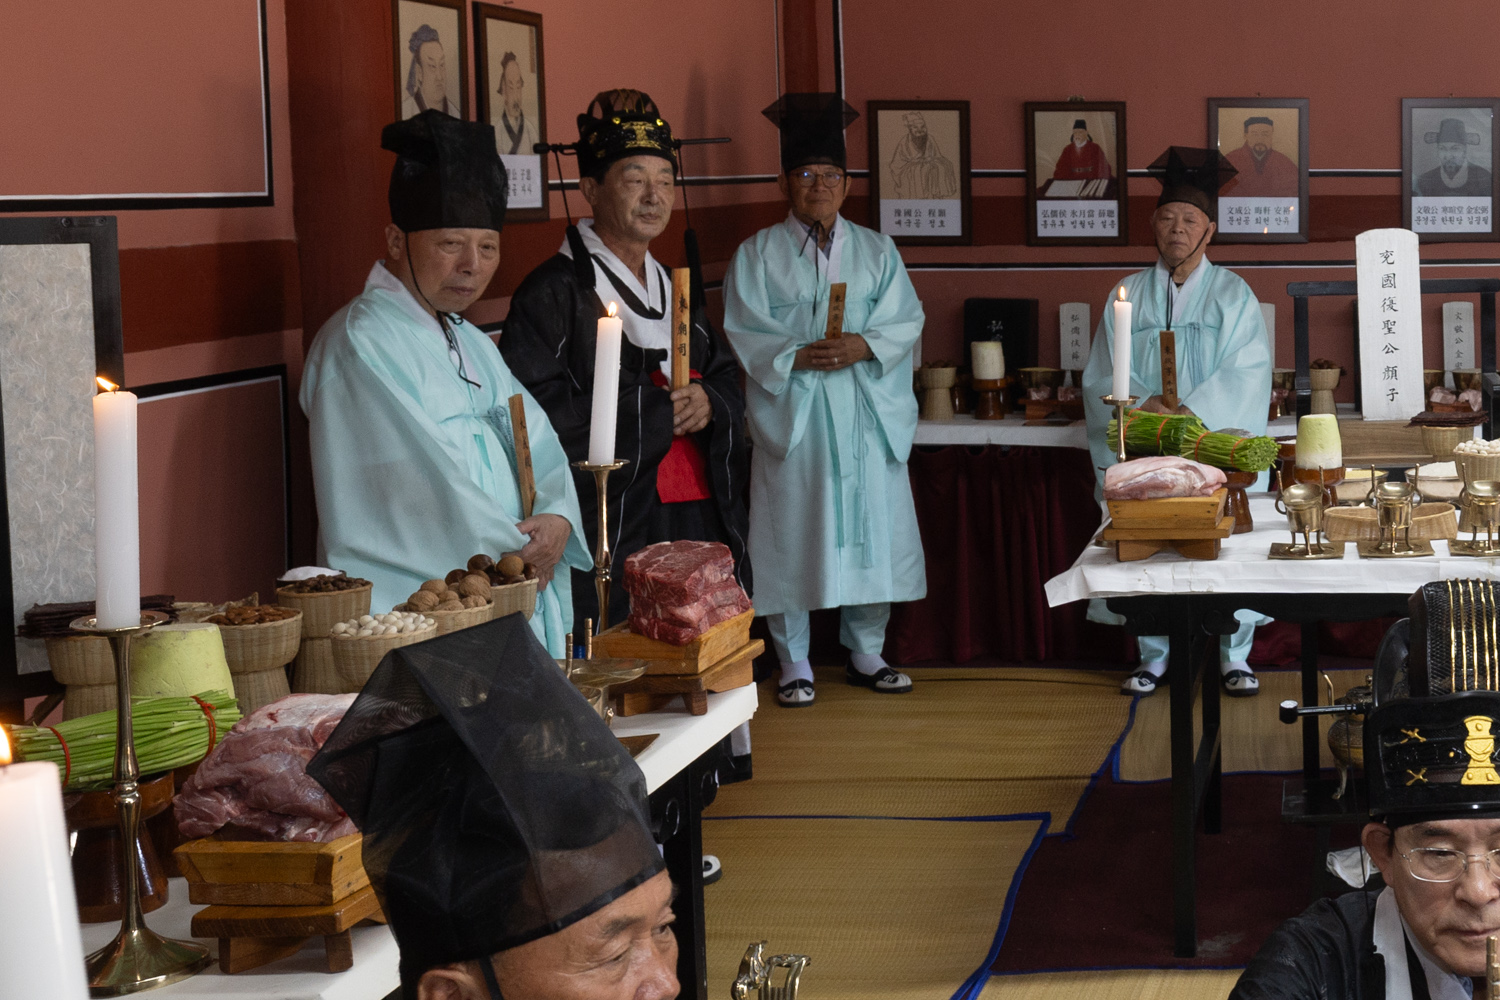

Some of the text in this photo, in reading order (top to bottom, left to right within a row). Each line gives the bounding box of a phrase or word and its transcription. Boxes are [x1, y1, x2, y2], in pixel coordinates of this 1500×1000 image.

[1227, 206, 1251, 215] 文成公
[929, 219, 946, 229] 정호
[1041, 219, 1065, 229] 홍유후
[1227, 216, 1290, 226] 문성공 회헌 안유
[1414, 216, 1437, 225] 문경공
